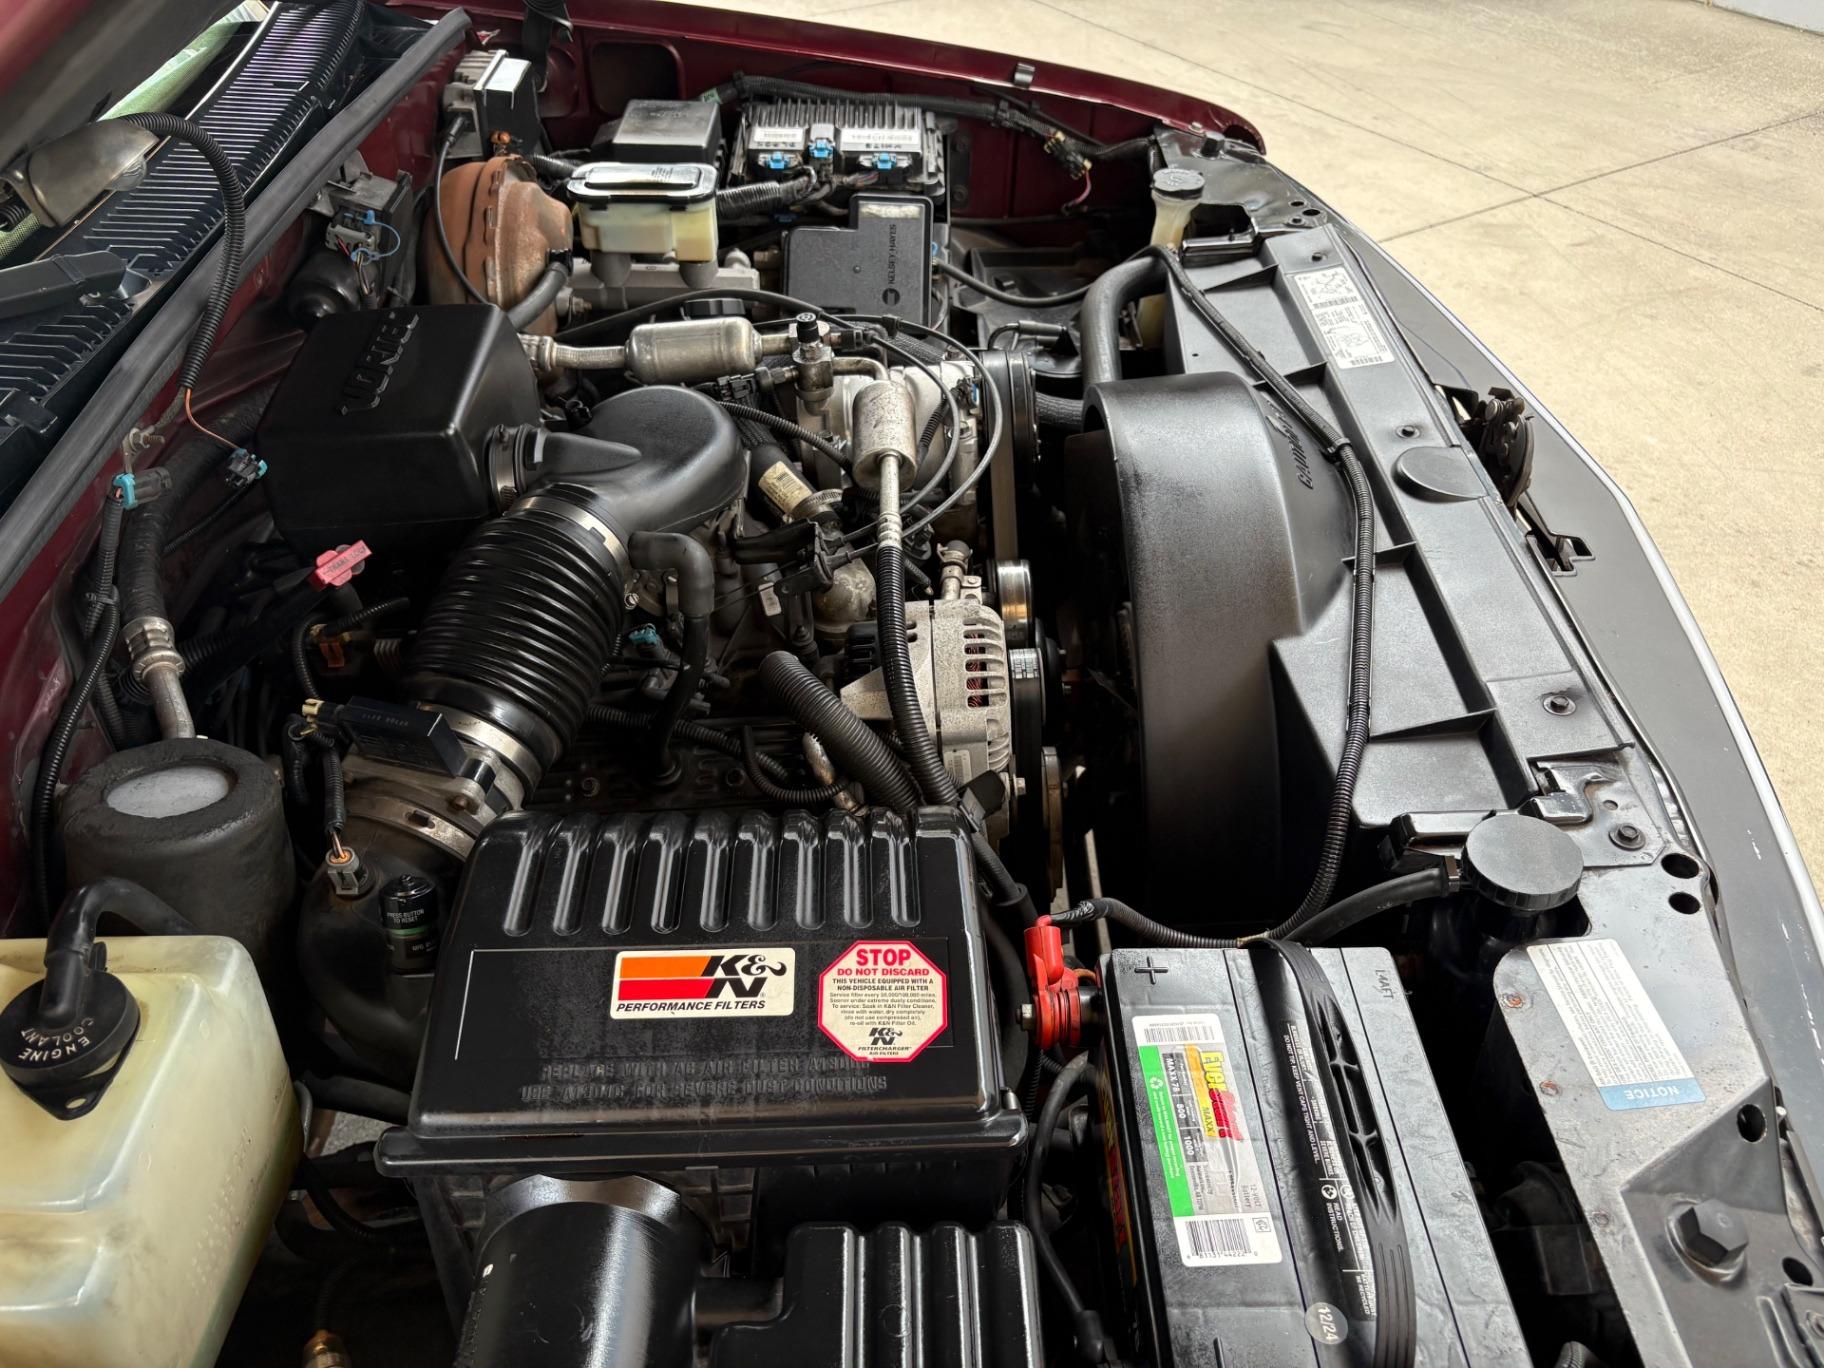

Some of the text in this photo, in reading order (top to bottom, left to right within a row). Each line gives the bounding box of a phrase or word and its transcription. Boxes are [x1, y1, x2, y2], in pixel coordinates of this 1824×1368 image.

[404, 909, 424, 917] BUTTON
[856, 949, 911, 966] STOP
[616, 1000, 766, 1012] PERFORMANCE FILTERS
[20, 1016, 94, 1046] COOLANT
[18, 1036, 90, 1062] ENGINE
[1285, 1043, 1293, 1054] NOT
[624, 1062, 667, 1077] WITH
[739, 1057, 800, 1075] FILTER
[1165, 1057, 1178, 1081] MAXX
[1290, 1065, 1300, 1079] KEEP
[744, 1078, 786, 1095] DUST
[794, 1075, 888, 1095] CONDITIONS
[1294, 1080, 1303, 1095] VENT
[1624, 1085, 1680, 1100] NOTICE
[1198, 1050, 1245, 1142] EverStart
[1298, 1095, 1307, 1111] CAPS
[1175, 1103, 1186, 1118] 800
[1201, 1105, 1215, 1133] MAXX
[1302, 1112, 1312, 1129] TIGHT
[1306, 1129, 1316, 1142] AND
[1182, 1135, 1195, 1155] 1000
[1333, 1202, 1343, 1221] READ
[1325, 1201, 1344, 1253] INSTRUCTIONS.
[1318, 1306, 1340, 1340] 12/24
